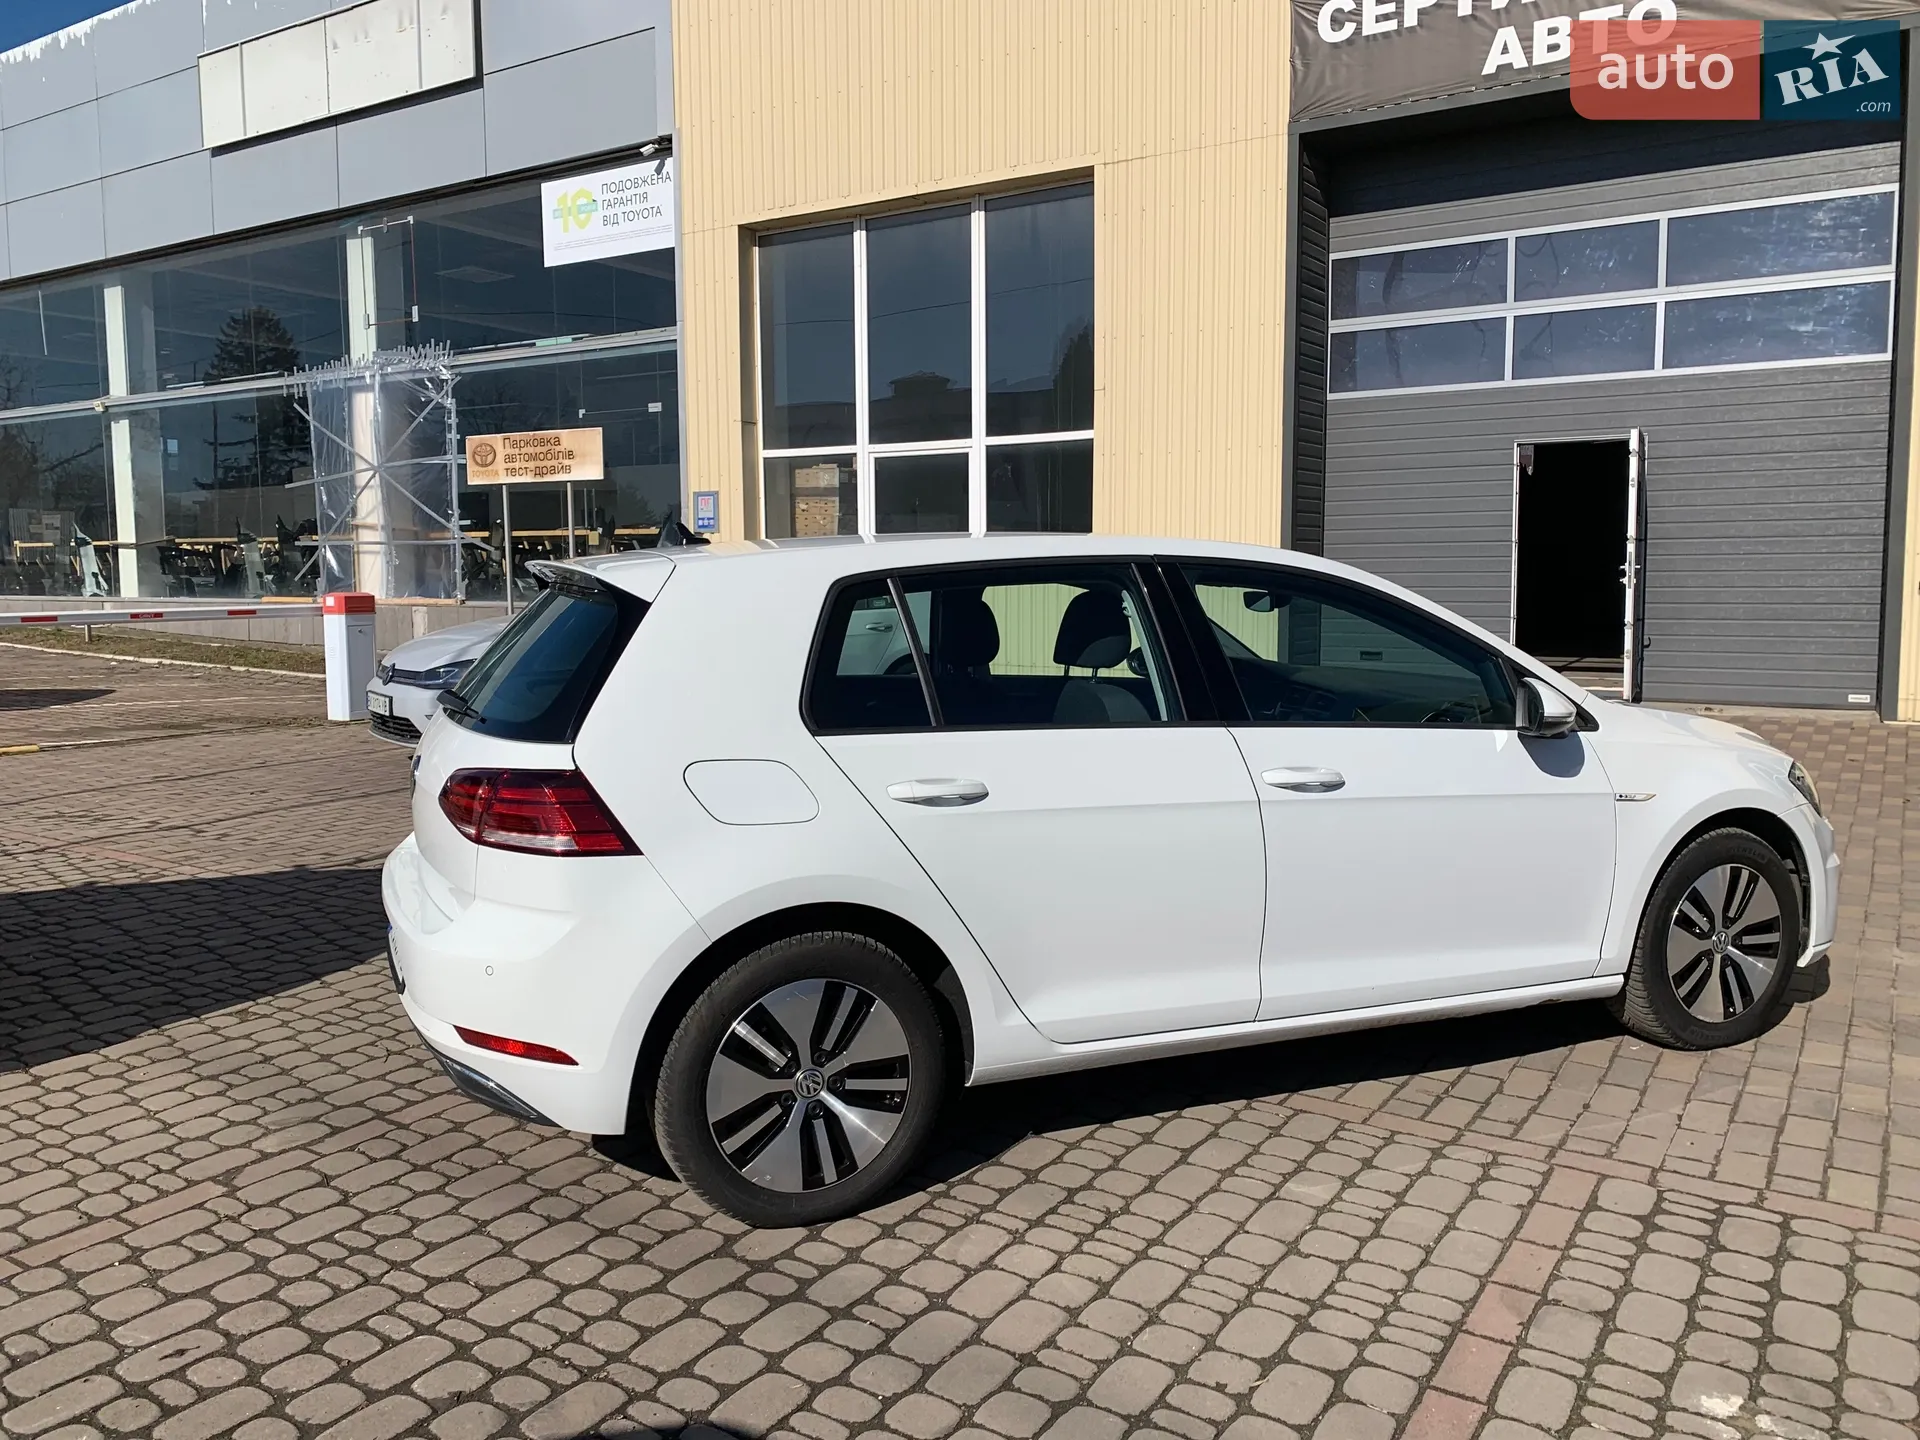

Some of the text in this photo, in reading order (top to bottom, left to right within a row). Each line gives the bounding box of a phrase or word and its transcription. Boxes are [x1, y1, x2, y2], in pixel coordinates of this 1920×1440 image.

[1481, 0, 1677, 76] АВТО
[601, 171, 672, 195] ПОДОВЖЕНА
[557, 187, 592, 233] 10
[602, 192, 648, 211] ГАРАНТІЯ
[602, 205, 662, 227] ВІД TOYOTA
[502, 436, 561, 451] Парковка
[504, 448, 574, 464] автомобілів
[505, 462, 571, 478] тест-драйв
